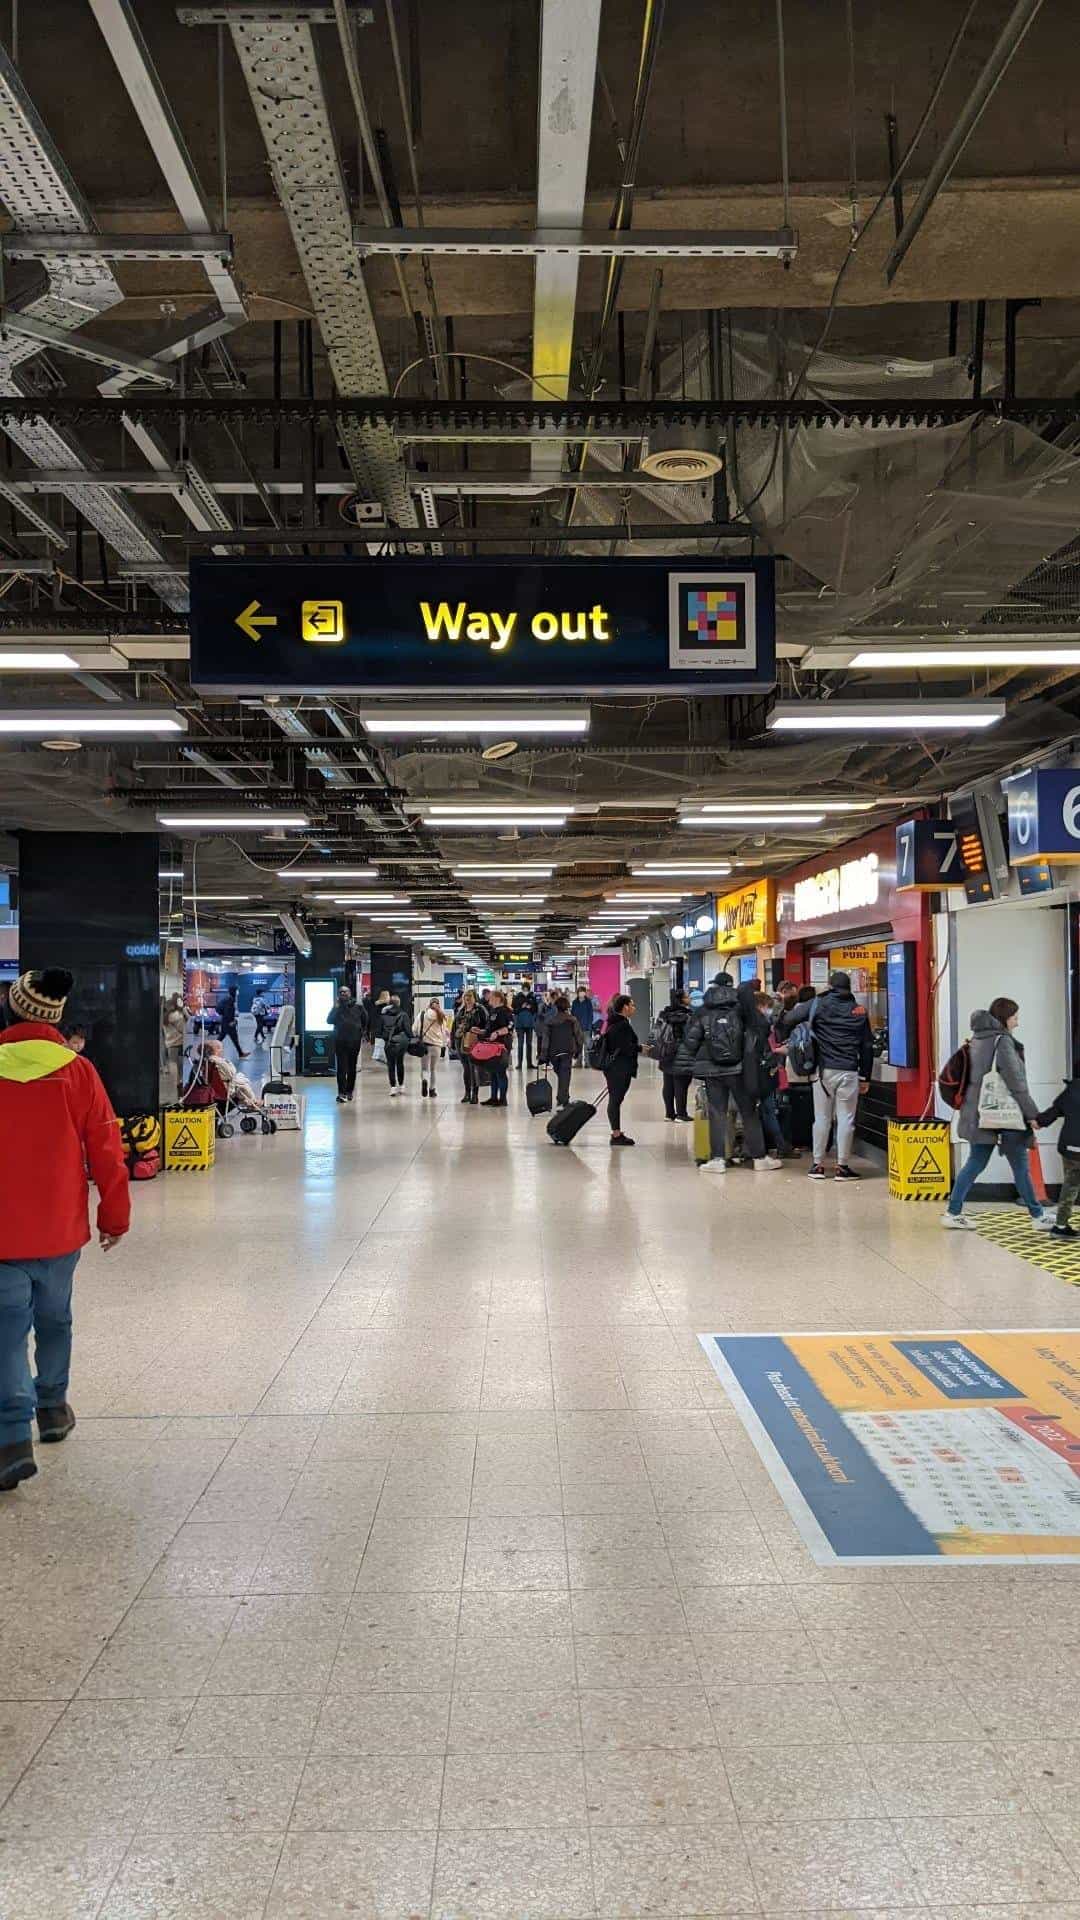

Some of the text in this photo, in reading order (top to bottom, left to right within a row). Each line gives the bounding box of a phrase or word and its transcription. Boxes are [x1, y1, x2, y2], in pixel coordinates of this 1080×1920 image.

[420, 602, 609, 650] Way out
[933, 832, 958, 873] 7
[842, 951, 869, 959] PURE
[906, 1136, 945, 1145] CAUTION
[1029, 1424, 1067, 1441] 2022
